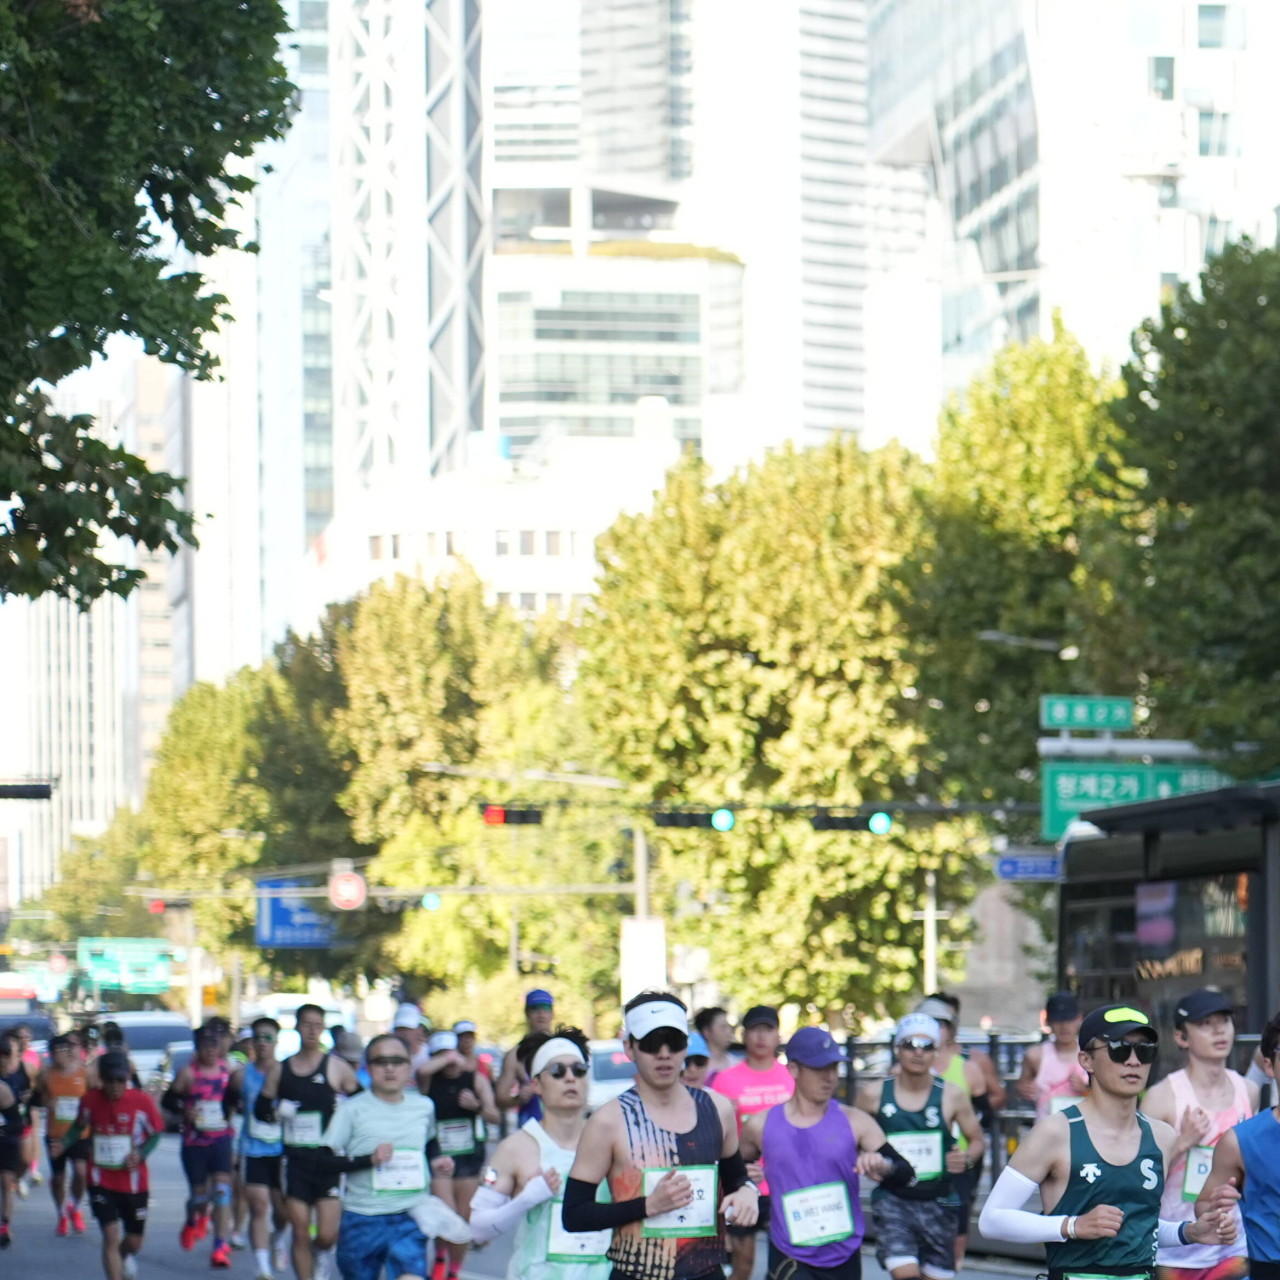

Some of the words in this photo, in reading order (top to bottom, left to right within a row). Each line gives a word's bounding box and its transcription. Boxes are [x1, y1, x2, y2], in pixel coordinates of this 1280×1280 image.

[1140, 1158, 1158, 1190] S
[1198, 1164, 1208, 1175] D
[793, 1211, 801, 1221] B
